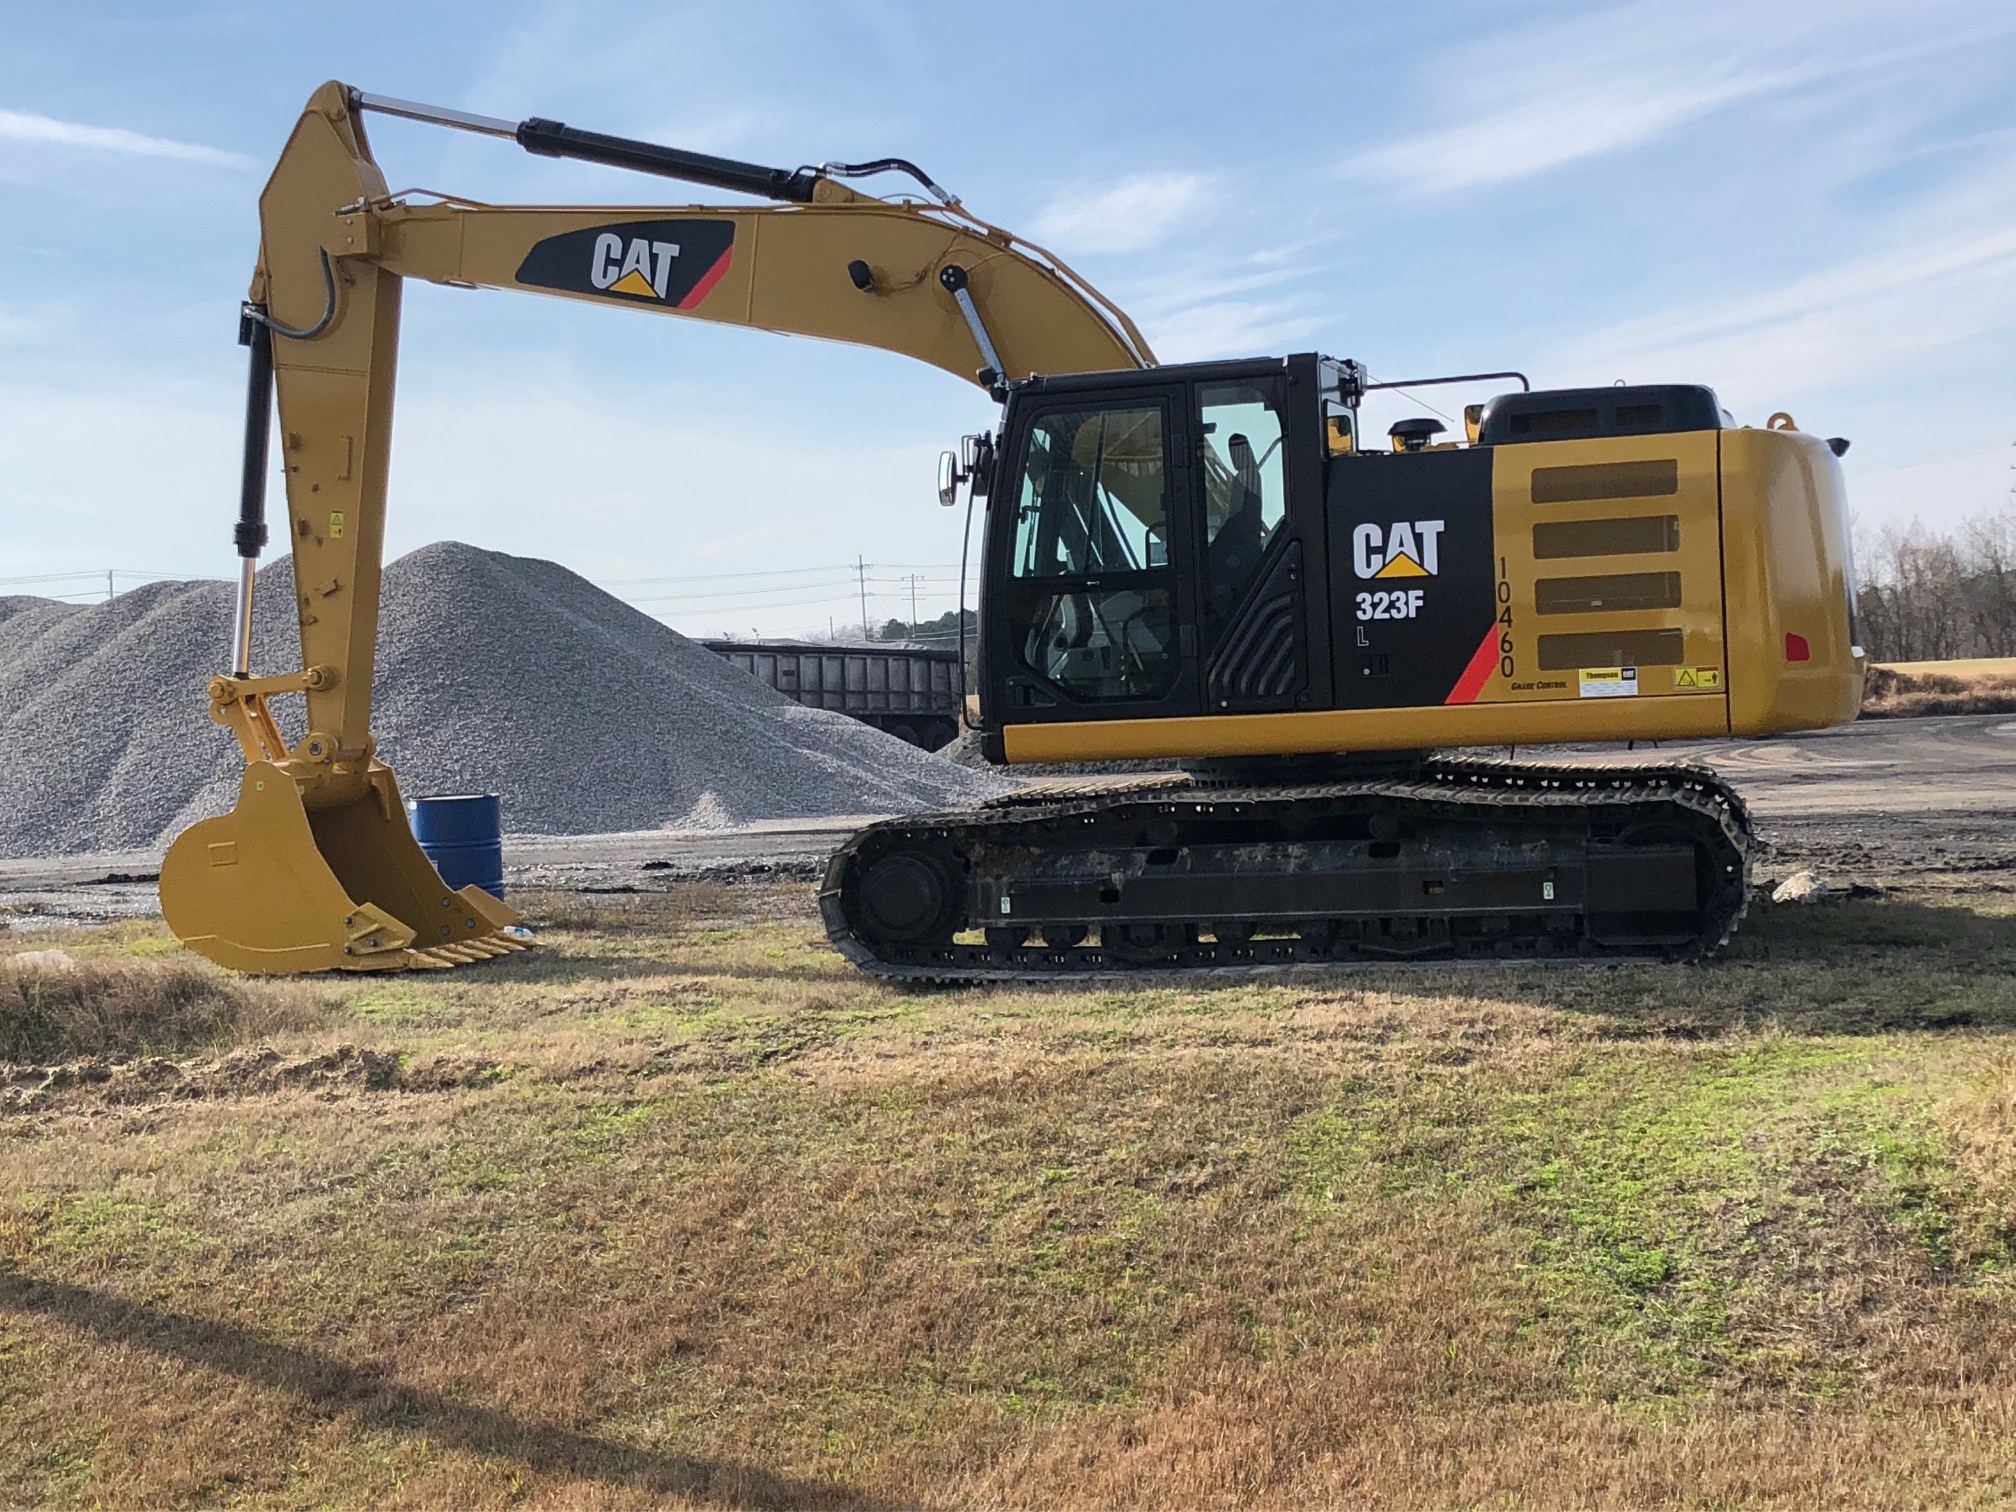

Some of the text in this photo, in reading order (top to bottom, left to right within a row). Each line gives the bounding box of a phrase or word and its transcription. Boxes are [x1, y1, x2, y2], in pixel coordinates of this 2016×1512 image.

[590, 232, 680, 299] CAT
[1353, 520, 1445, 579] CAT
[1356, 590, 1424, 620] 323F
[1498, 556, 1514, 678] 10460
[1357, 626, 1369, 646] L
